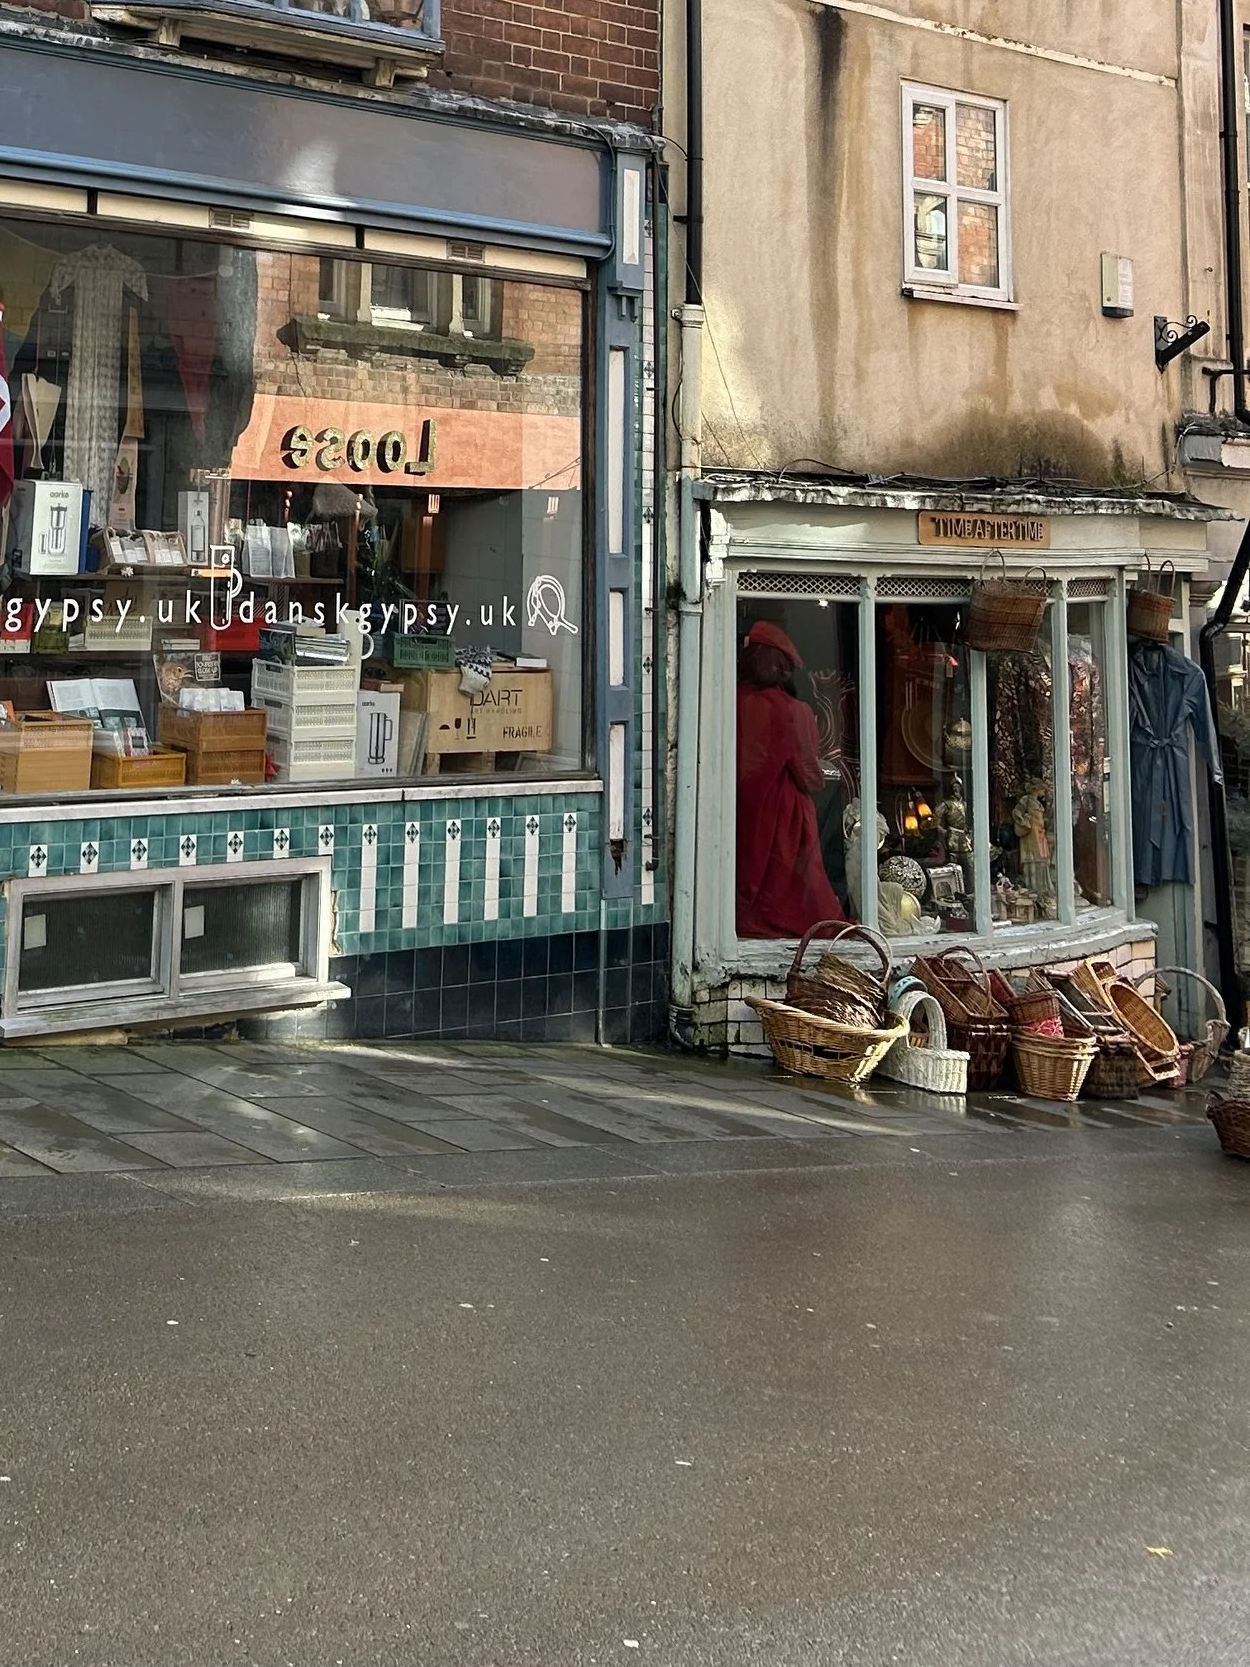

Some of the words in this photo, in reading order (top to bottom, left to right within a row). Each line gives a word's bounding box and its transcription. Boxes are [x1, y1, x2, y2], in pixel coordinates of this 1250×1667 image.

[931, 517, 972, 537] TIME
[975, 518, 1015, 540] AFTER
[1017, 521, 1043, 542] TIME
[239, 591, 516, 635] danskgypsy.uk
[470, 689, 523, 706] DART
[503, 725, 542, 739] FRAGILE
